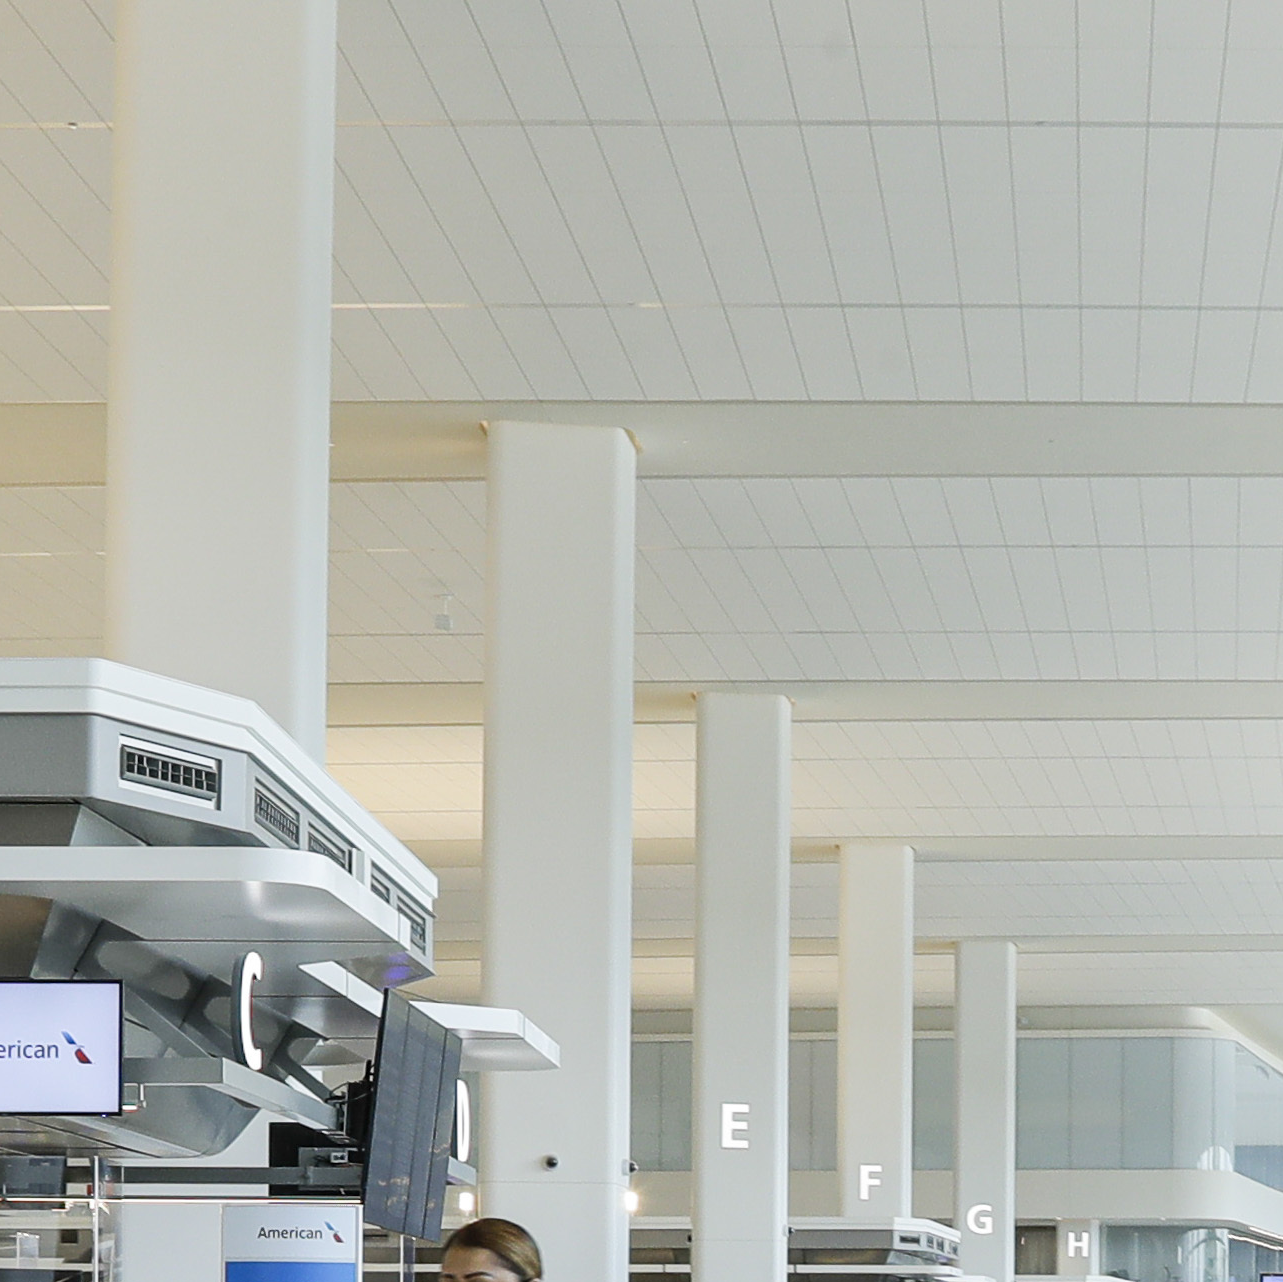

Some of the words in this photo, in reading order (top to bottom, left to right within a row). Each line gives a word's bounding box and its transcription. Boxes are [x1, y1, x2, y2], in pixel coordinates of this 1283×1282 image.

[239, 951, 263, 1071] C
[721, 1103, 750, 1149] E
[859, 1164, 883, 1200] F
[257, 1227, 323, 1239] American
[966, 1204, 994, 1235] G
[1067, 1232, 1089, 1258] H
